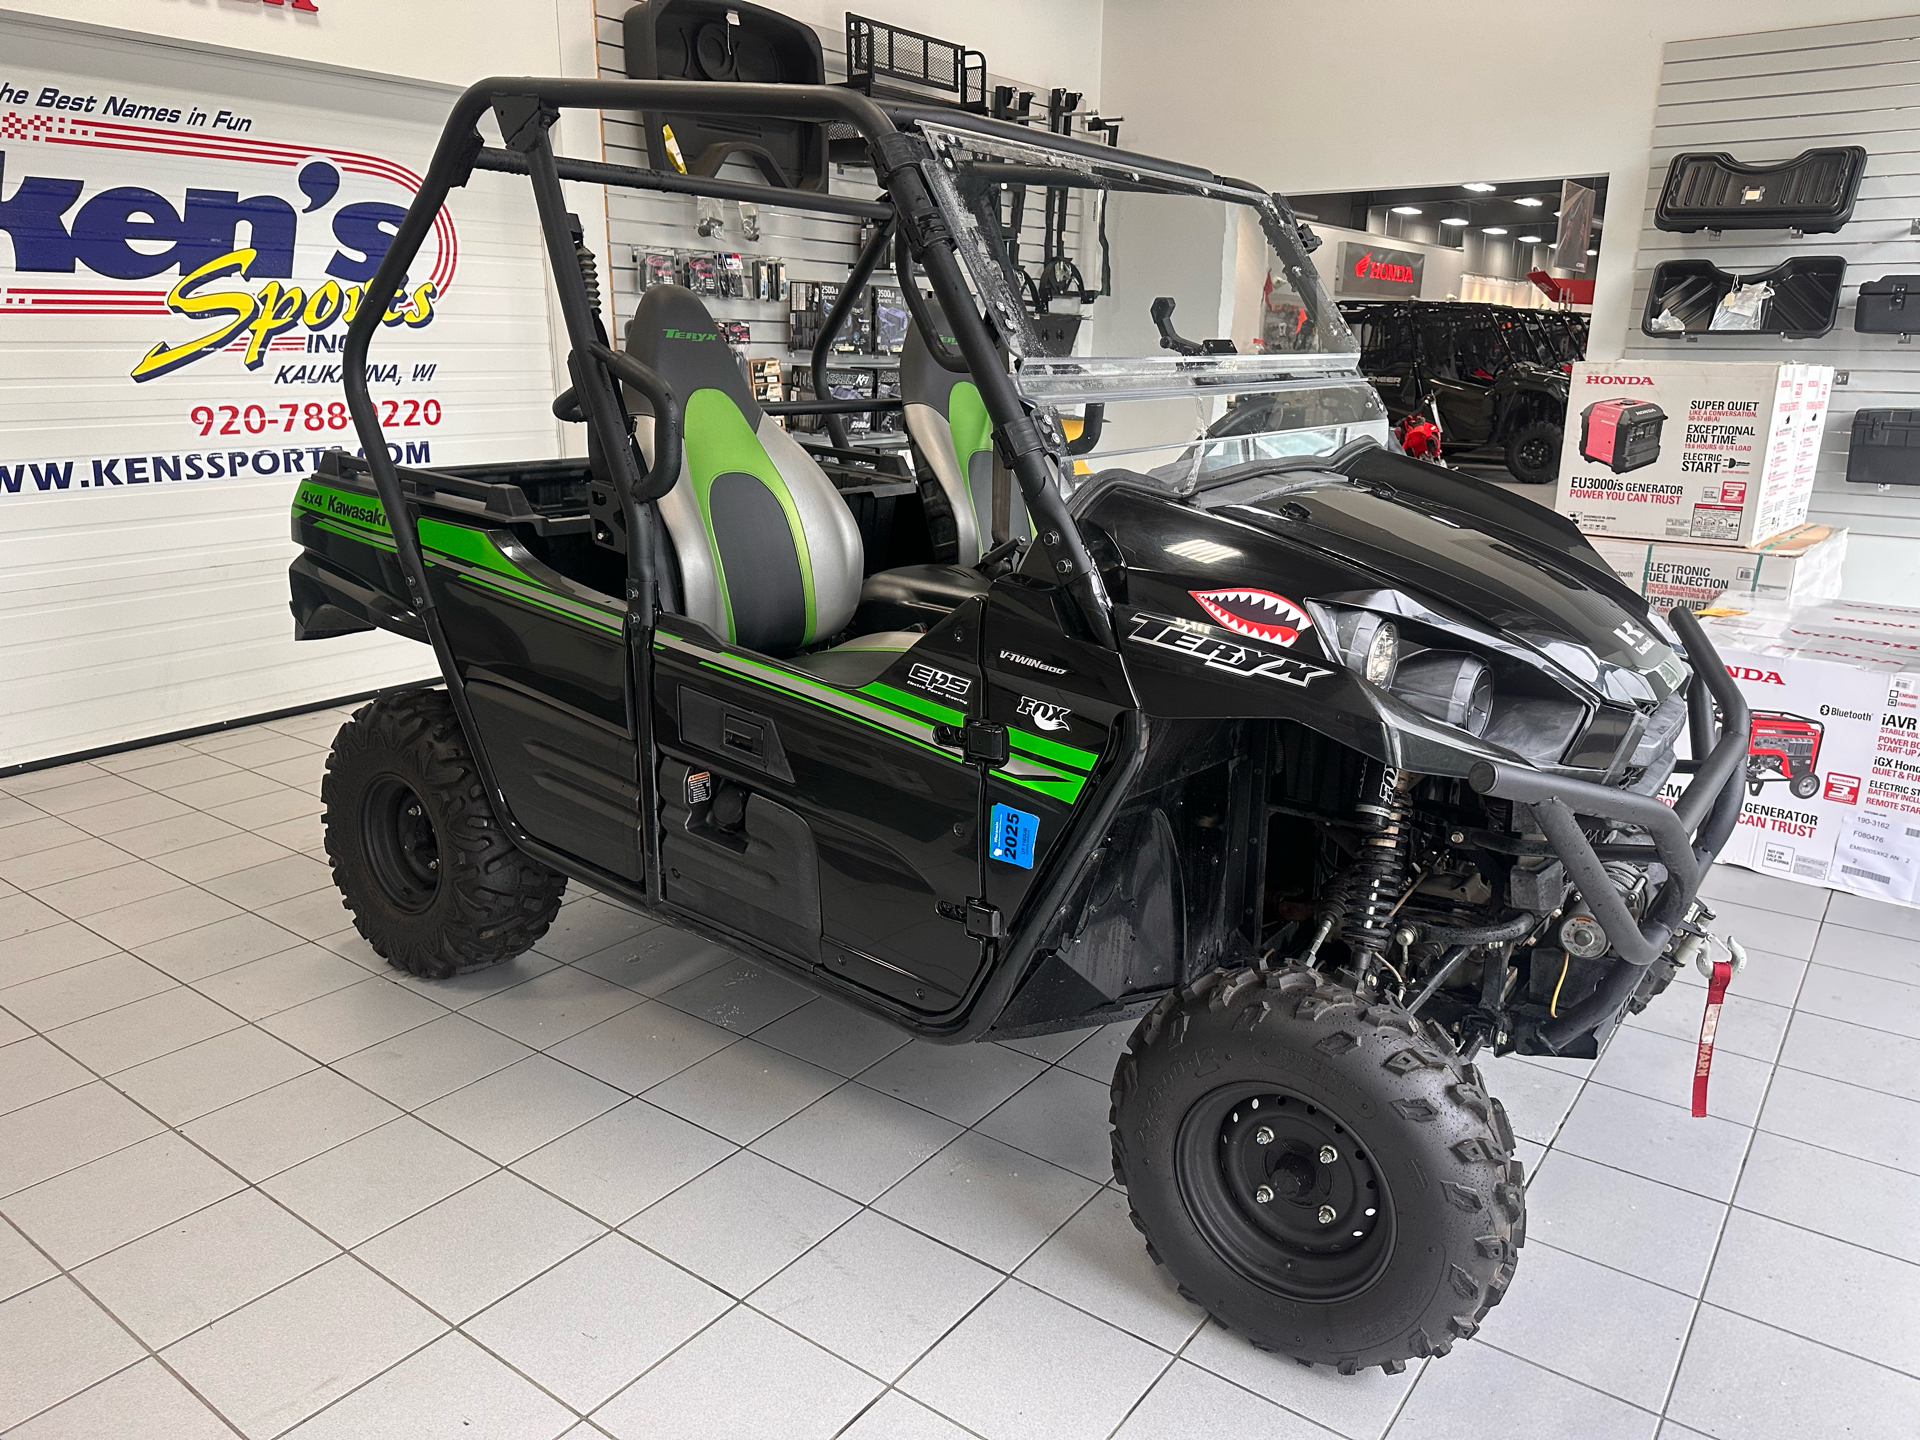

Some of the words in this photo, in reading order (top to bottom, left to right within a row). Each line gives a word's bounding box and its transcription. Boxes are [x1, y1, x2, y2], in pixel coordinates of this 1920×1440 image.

[36, 87, 97, 112] Best
[102, 96, 181, 123] Names
[187, 107, 207, 126] in
[212, 110, 252, 132] Fun
[1370, 260, 1414, 283] HONDA
[412, 363, 438, 382] WI
[1585, 375, 1654, 386] HONDA
[1690, 400, 1725, 411] SUPER
[1727, 401, 1760, 411] QUIET
[1708, 410, 1758, 418] CONVERSATION,
[1687, 424, 1756, 436] EXCEPTIONAL
[1685, 434, 1708, 443] RUN
[1711, 435, 1737, 445] TIME
[1682, 453, 1722, 462] ELECTRIC
[1681, 460, 1721, 474] START
[1571, 476, 1624, 491] EU3000is
[1625, 482, 1684, 495] GENERATOR
[1569, 488, 1604, 499] POWER
[1606, 491, 1625, 501] YOU
[1626, 492, 1648, 502] CAN
[1650, 493, 1682, 505] TRUST
[301, 489, 323, 507] 4x4
[327, 494, 387, 527] Kawasaki
[1649, 562, 1711, 577] LECTRONIC
[1648, 573, 1669, 584] UEL
[1671, 575, 1729, 590] INJECTION
[1657, 589, 1700, 600] CARBURETORS
[1669, 584, 1712, 595] MAINTENANCE
[1646, 595, 1674, 607] UPER
[1677, 598, 1709, 611] QUIET
[1128, 612, 1336, 688] TERYX
[1725, 664, 1786, 686] NDA
[1016, 695, 1072, 722] FOX
[1831, 707, 1874, 722] Bluetooth
[1881, 713, 1918, 731] iAVR
[1880, 726, 1906, 738] STABLE
[1878, 735, 1909, 749] POWER
[1877, 743, 1917, 758] START-UP
[1874, 756, 1894, 770] iGX
[1872, 766, 1899, 779] QUIET
[1898, 771, 1905, 780] &
[1379, 764, 1400, 804] FO
[1869, 779, 1909, 796] ELECTRIC
[1867, 787, 1900, 800] BATTERY
[1865, 796, 1899, 811] REMOTE
[1744, 802, 1818, 826] GENERATOR
[1736, 811, 1767, 829] CAN
[1771, 818, 1816, 838] TRUST
[1857, 816, 1890, 829] 190-3162
[1004, 812, 1019, 861] 2025
[1853, 830, 1884, 843] F080476
[1696, 1043, 1712, 1077] WARN
